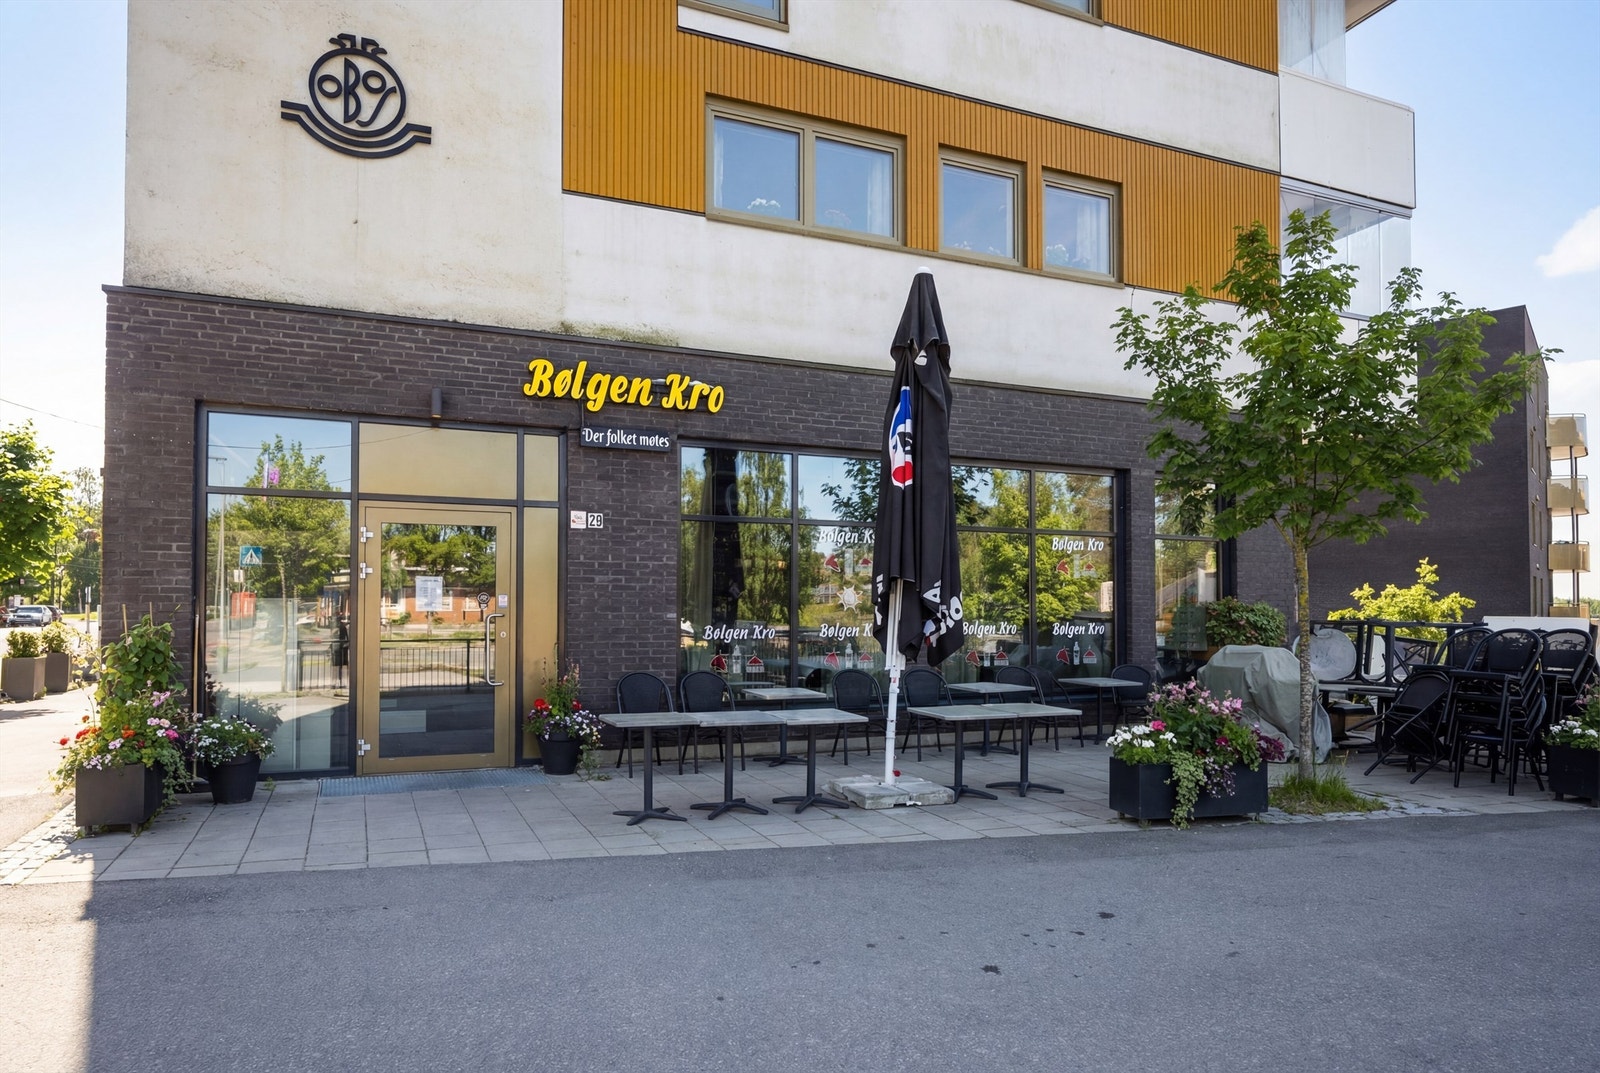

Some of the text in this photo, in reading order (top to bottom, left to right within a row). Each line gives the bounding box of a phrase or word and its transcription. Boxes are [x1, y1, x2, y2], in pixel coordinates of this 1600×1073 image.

[523, 358, 725, 413] Bølgen Kro
[581, 427, 670, 448] Der folket møtes
[589, 514, 603, 527] 29
[1087, 537, 1104, 551] Kro
[752, 624, 776, 639] Kro
[998, 621, 1017, 635] Kro
[1087, 622, 1105, 635] Kro
